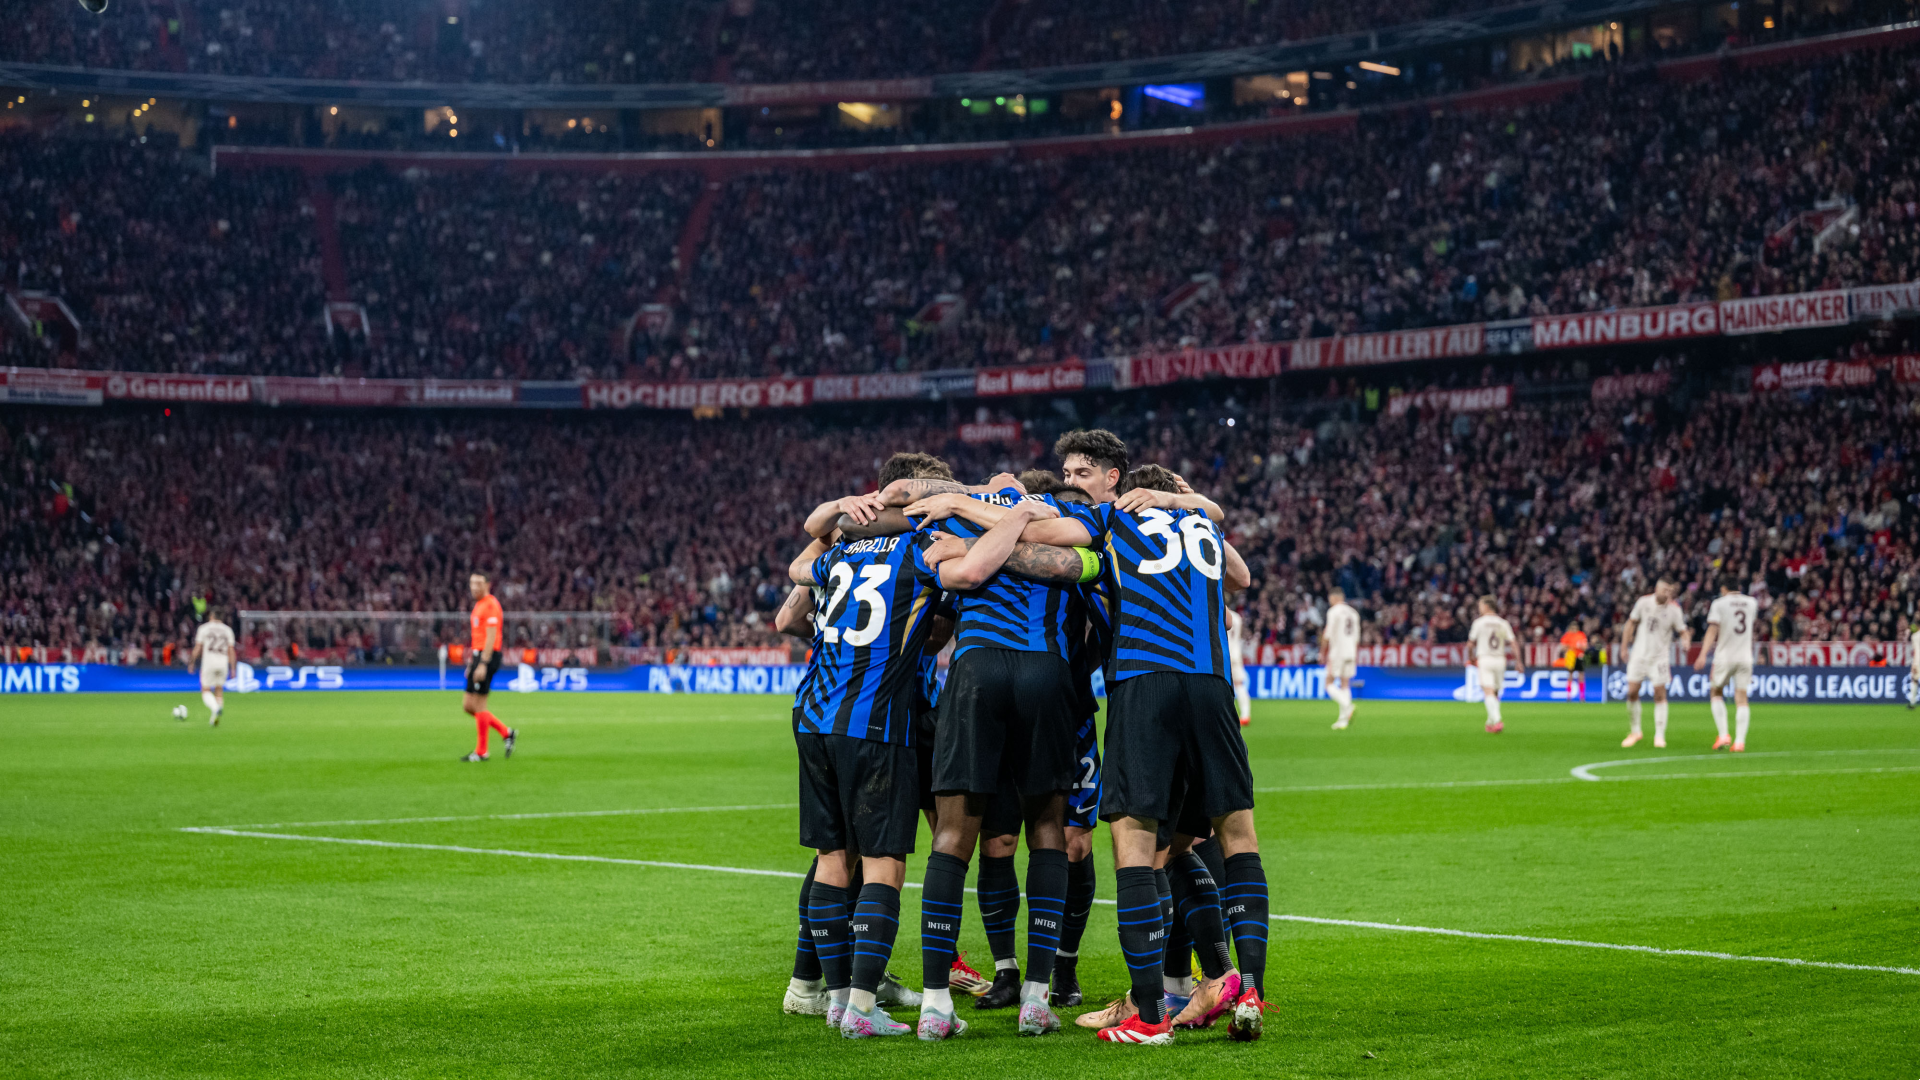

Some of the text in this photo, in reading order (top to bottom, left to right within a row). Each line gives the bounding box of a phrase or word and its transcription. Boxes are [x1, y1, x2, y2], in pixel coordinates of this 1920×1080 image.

[1722, 295, 1845, 330] HAINSACKER
[1533, 306, 1717, 347] MAINBURG
[1291, 341, 1320, 369] AU
[1343, 324, 1481, 365] HALLERTAU
[130, 378, 249, 400] Geisenfeld
[587, 382, 760, 408] HOCHBERG
[844, 536, 900, 554] BARELLA
[1137, 508, 1222, 581] 36
[824, 561, 892, 647] 23
[1733, 610, 1747, 635] 3
[207, 633, 228, 653] 22
[1488, 630, 1499, 651] 6
[0, 665, 80, 692] MITS
[266, 666, 343, 690] PS5
[541, 667, 588, 690] PS5
[695, 667, 734, 692] HAS
[737, 666, 769, 693] NO
[1257, 667, 1329, 699] LIMIT
[1498, 670, 1579, 699] PS5
[1815, 674, 1897, 699] LEAGUE
[1227, 904, 1246, 917] NTER
[927, 921, 951, 931] INTER
[1034, 917, 1057, 930] INTER
